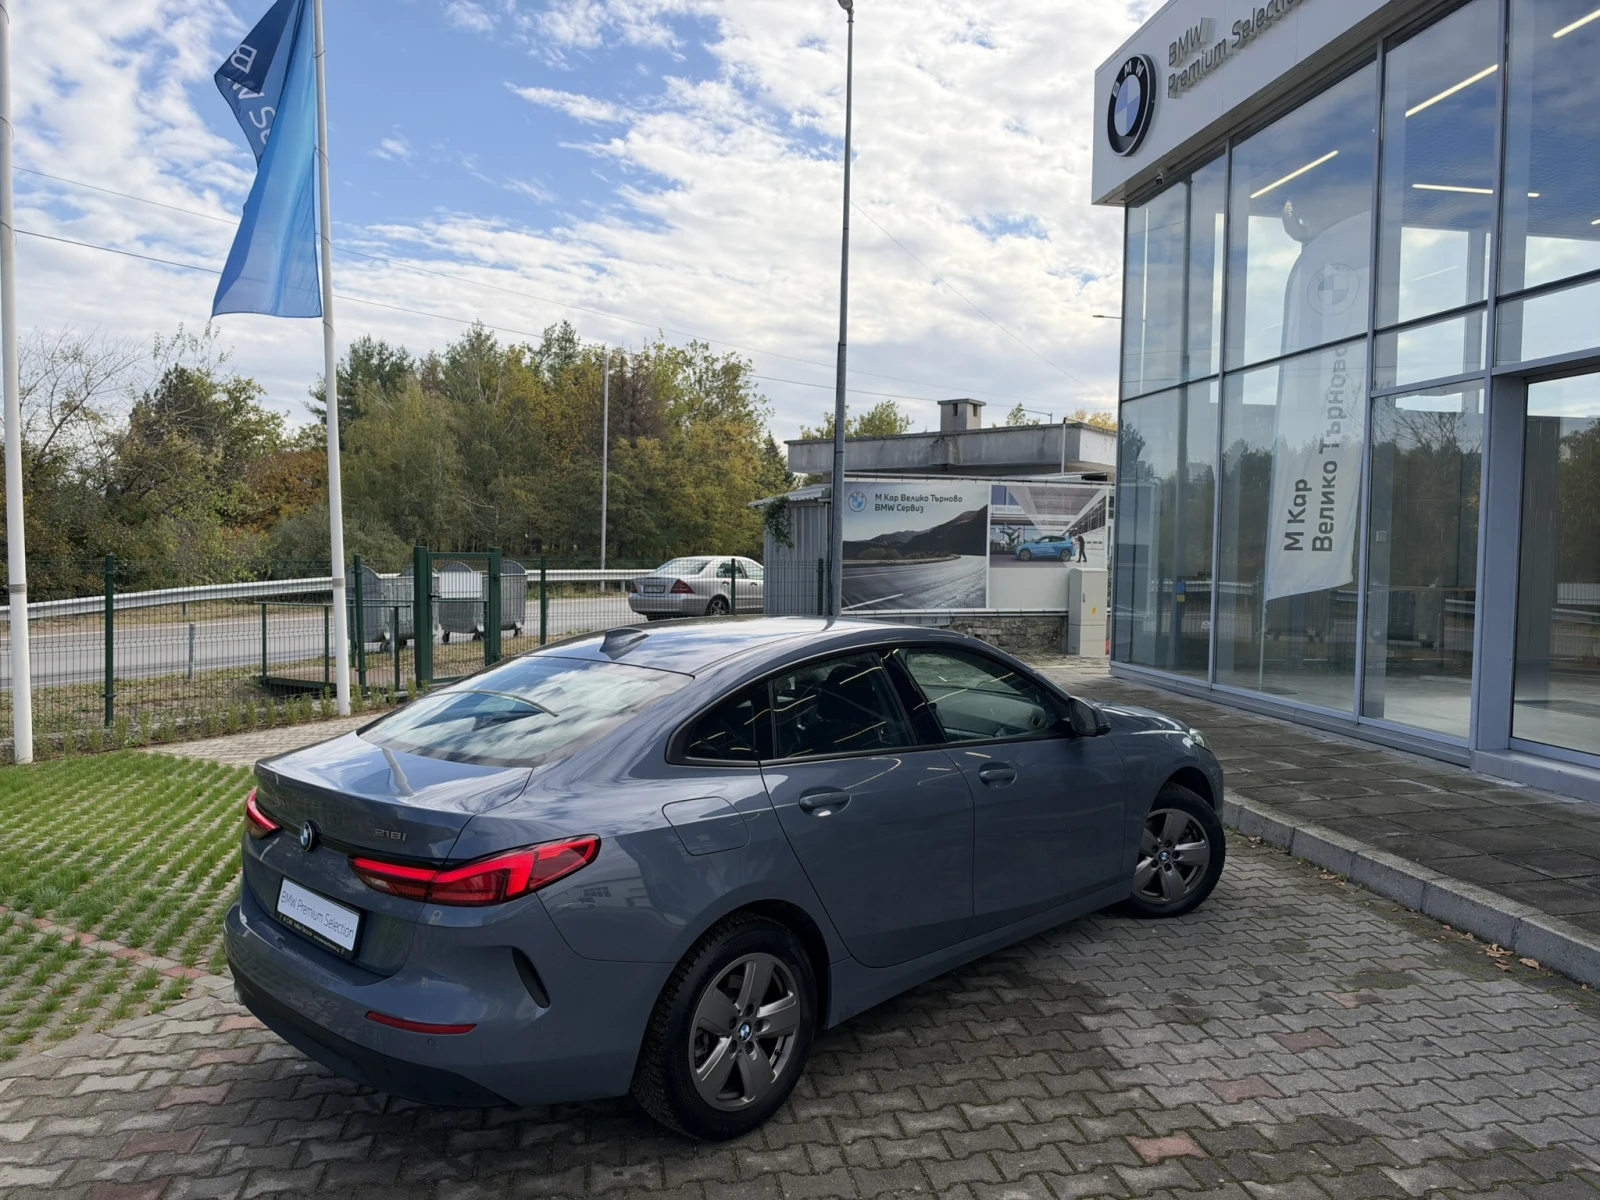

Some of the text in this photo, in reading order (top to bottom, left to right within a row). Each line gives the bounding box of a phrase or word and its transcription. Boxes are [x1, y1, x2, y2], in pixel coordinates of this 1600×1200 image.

[1169, 17, 1204, 67] BMW
[1111, 60, 1145, 98] BMW
[1168, 38, 1228, 98] Premium
[874, 503, 924, 513] BMW Сервиз
[884, 493, 899, 503] Кар
[900, 493, 929, 502] Велико
[930, 494, 963, 504] Търново
[1287, 478, 1313, 525] Кар
[1311, 460, 1338, 552] Велико
[281, 890, 298, 909] BMW
[297, 899, 324, 924] Premium
[323, 913, 354, 940] Selection
